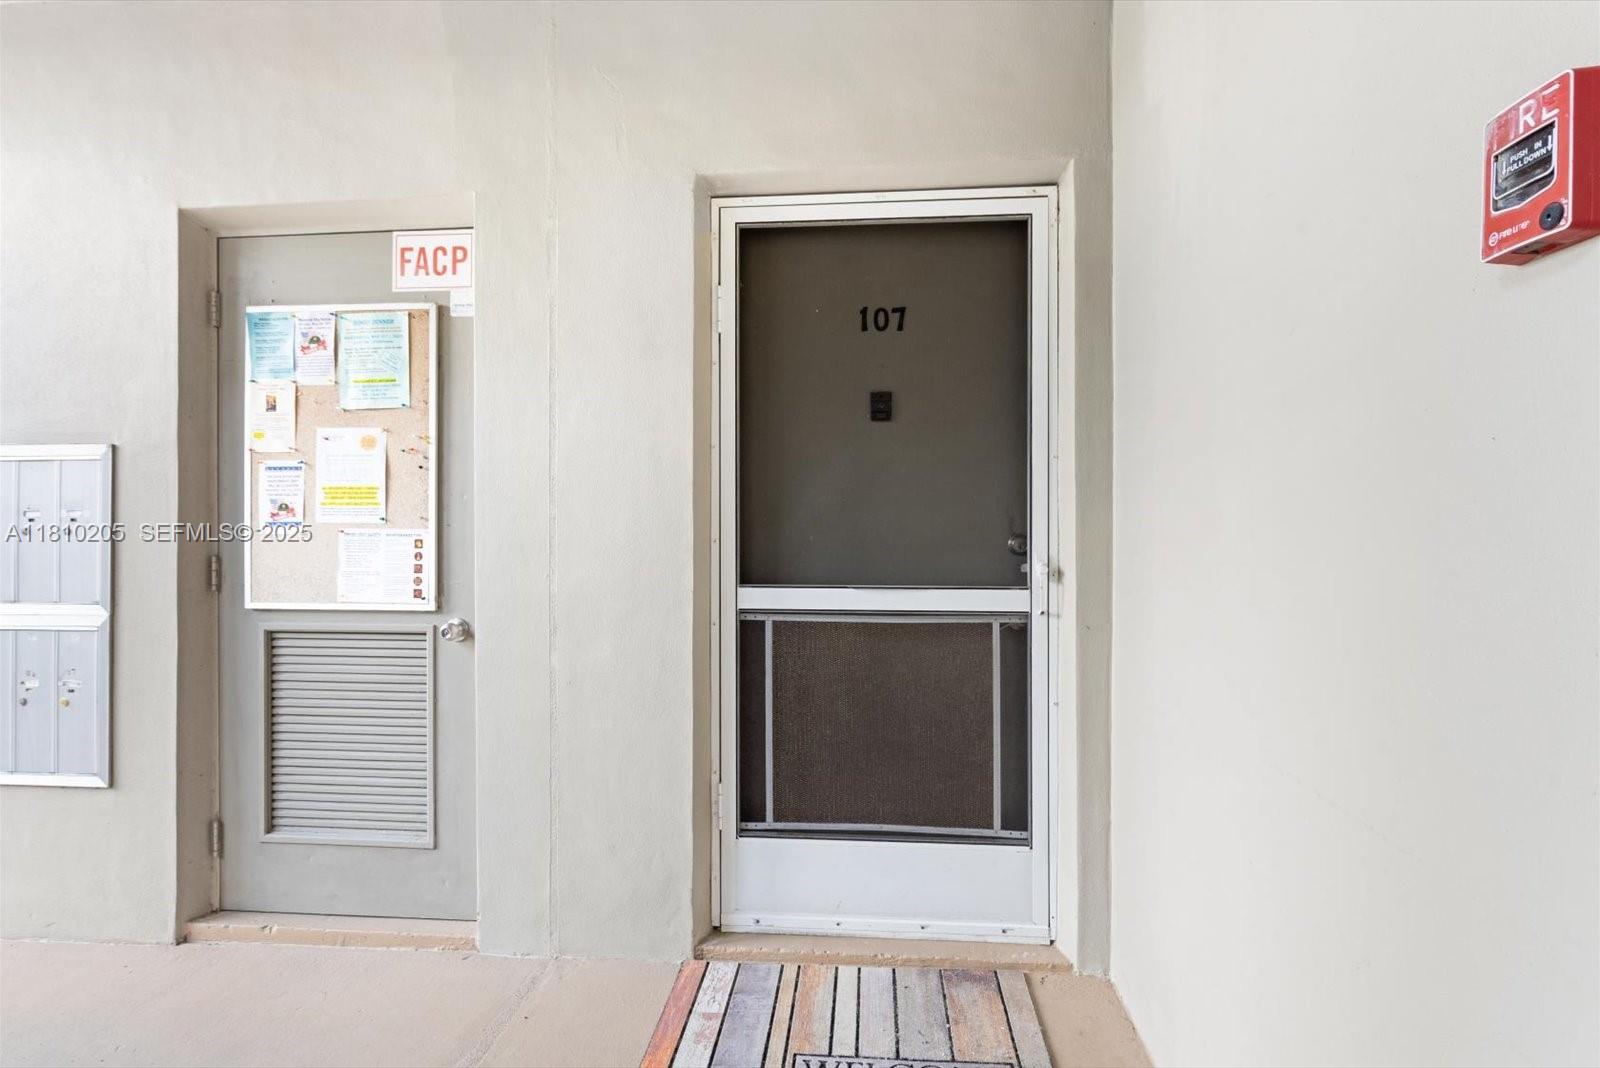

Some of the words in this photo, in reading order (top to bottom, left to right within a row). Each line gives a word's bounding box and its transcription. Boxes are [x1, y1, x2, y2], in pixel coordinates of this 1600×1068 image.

[1506, 160, 1523, 175] PULL
[1523, 147, 1547, 164] DOWN
[1510, 147, 1528, 163] PUSH
[1533, 140, 1543, 150] IN
[400, 246, 468, 276] FACP
[860, 306, 907, 332] 107
